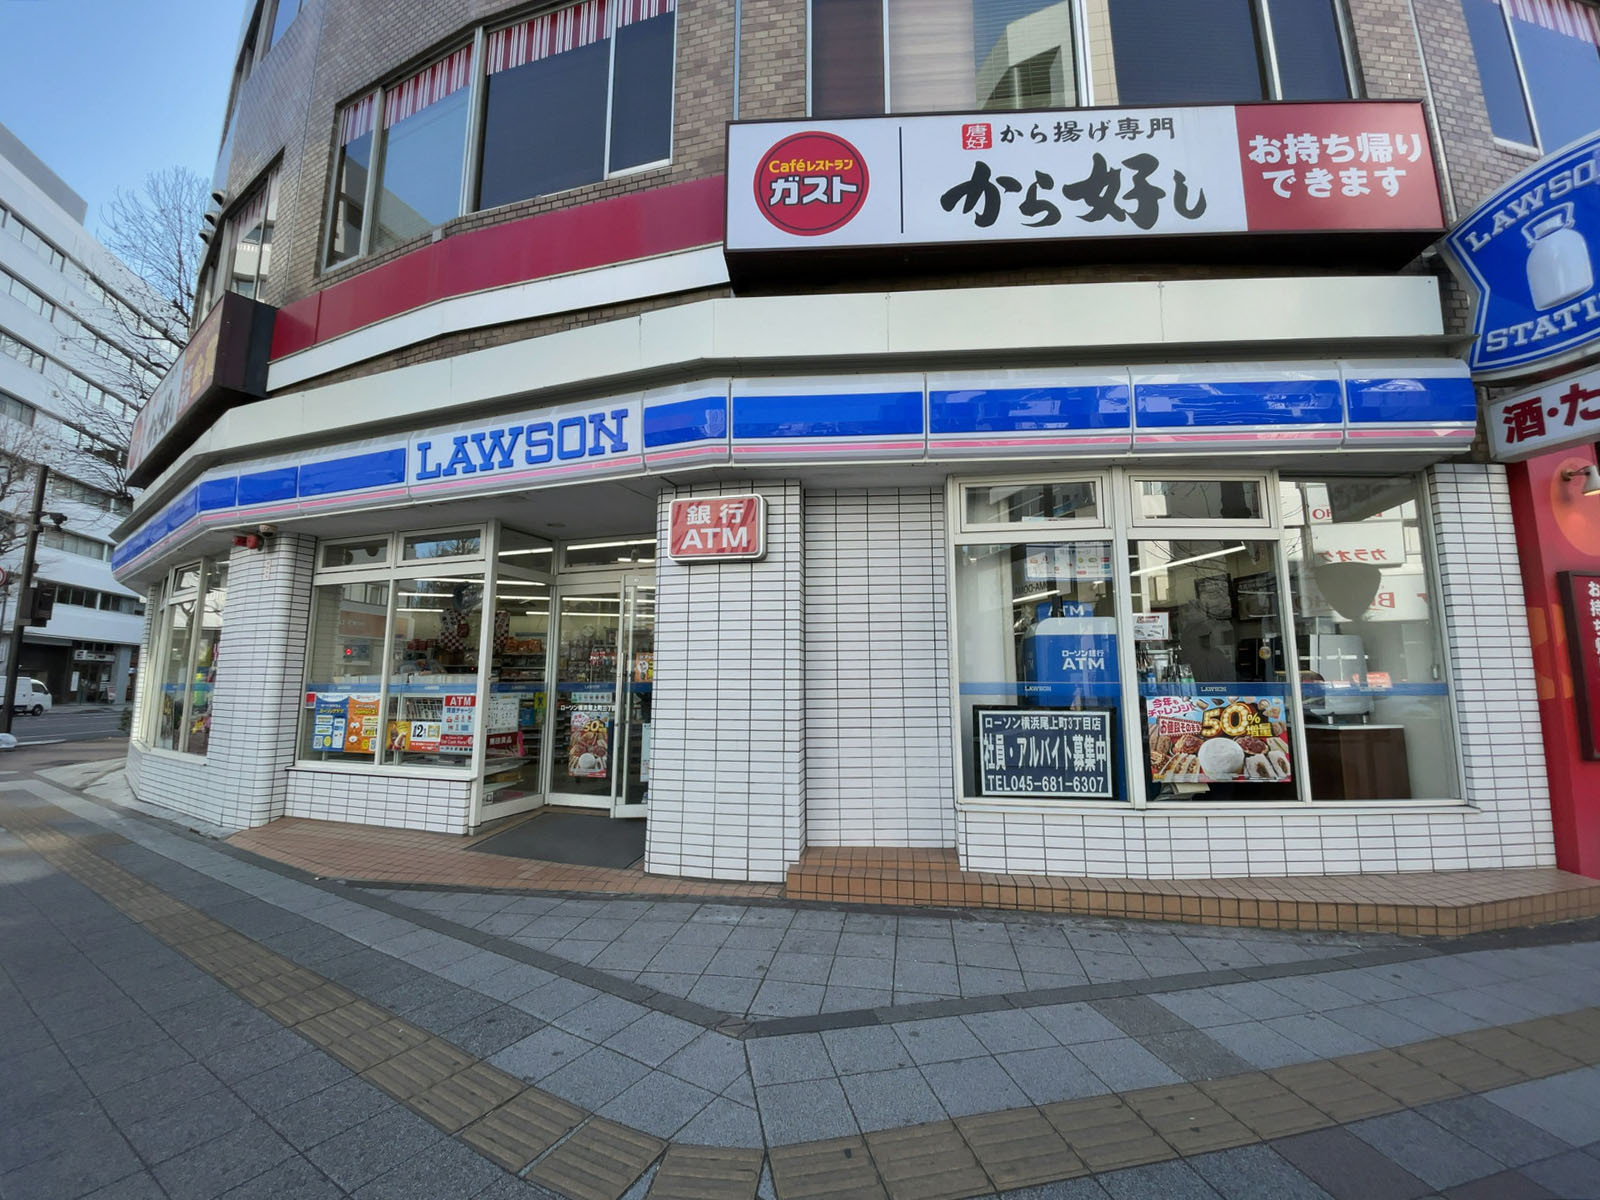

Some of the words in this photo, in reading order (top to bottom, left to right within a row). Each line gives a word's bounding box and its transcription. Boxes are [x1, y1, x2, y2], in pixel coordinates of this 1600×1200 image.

[1000, 116, 1176, 144] から揚げ専門
[1248, 132, 1422, 165] お持ち帰り
[768, 158, 854, 173] Caféレストラン
[769, 175, 858, 206] ガスト
[940, 152, 1207, 230] から好し
[1262, 166, 1407, 199] できます
[1465, 159, 1600, 252] LAWSO
[1486, 293, 1600, 352] STATI
[416, 408, 629, 481] LAWSON
[686, 503, 744, 525] 銀行
[680, 526, 748, 550] ATM
[1061, 649, 1104, 657] ローソン銀行
[1062, 657, 1105, 671] ATM
[449, 696, 472, 706] ATM
[985, 716, 1101, 731] ローソン横浜尾上町3丁目店
[1247, 722, 1273, 737] 増量
[983, 733, 1107, 772] 社員・アルバイト募集中
[987, 775, 1104, 793] TEL045-681-6307
